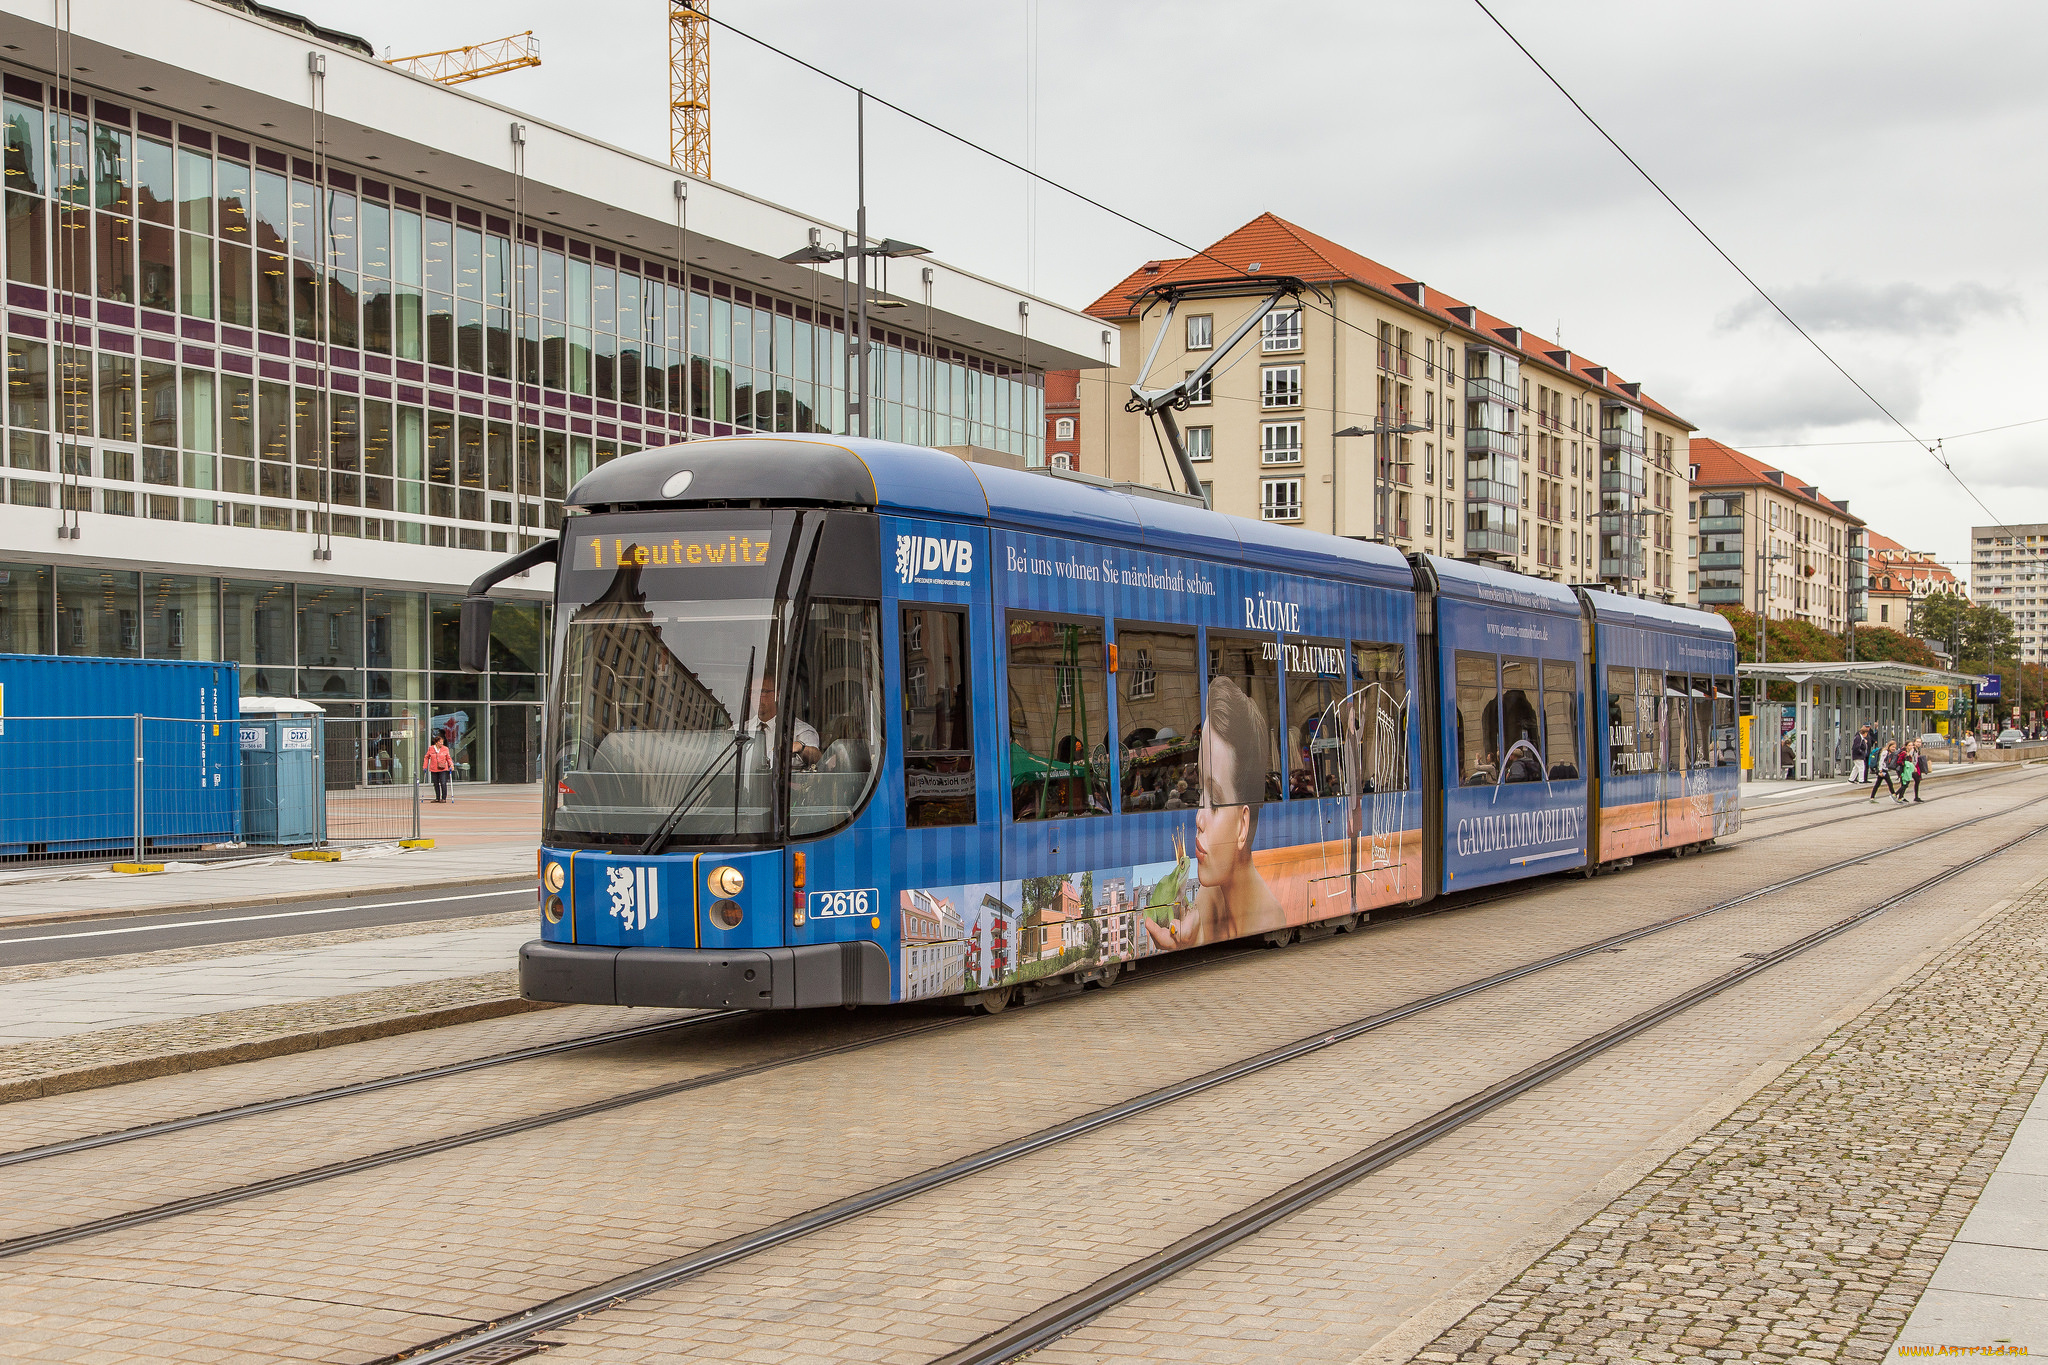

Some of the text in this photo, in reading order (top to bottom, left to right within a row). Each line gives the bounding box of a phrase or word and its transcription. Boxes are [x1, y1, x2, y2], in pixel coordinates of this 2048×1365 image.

[590, 536, 769, 568] 1 Leutewitz
[923, 537, 973, 574] DVB
[1006, 545, 1216, 596] Bei uns wohnen Sie märchenhaft schön.
[1244, 591, 1300, 633] RÄUME
[1262, 640, 1346, 675] ZUM TRÄUMEN
[1609, 720, 1634, 747] RÄUME
[1626, 748, 1654, 771] TRÄUMEN
[1457, 813, 1509, 857] GAMMA
[820, 891, 869, 916] 2616
